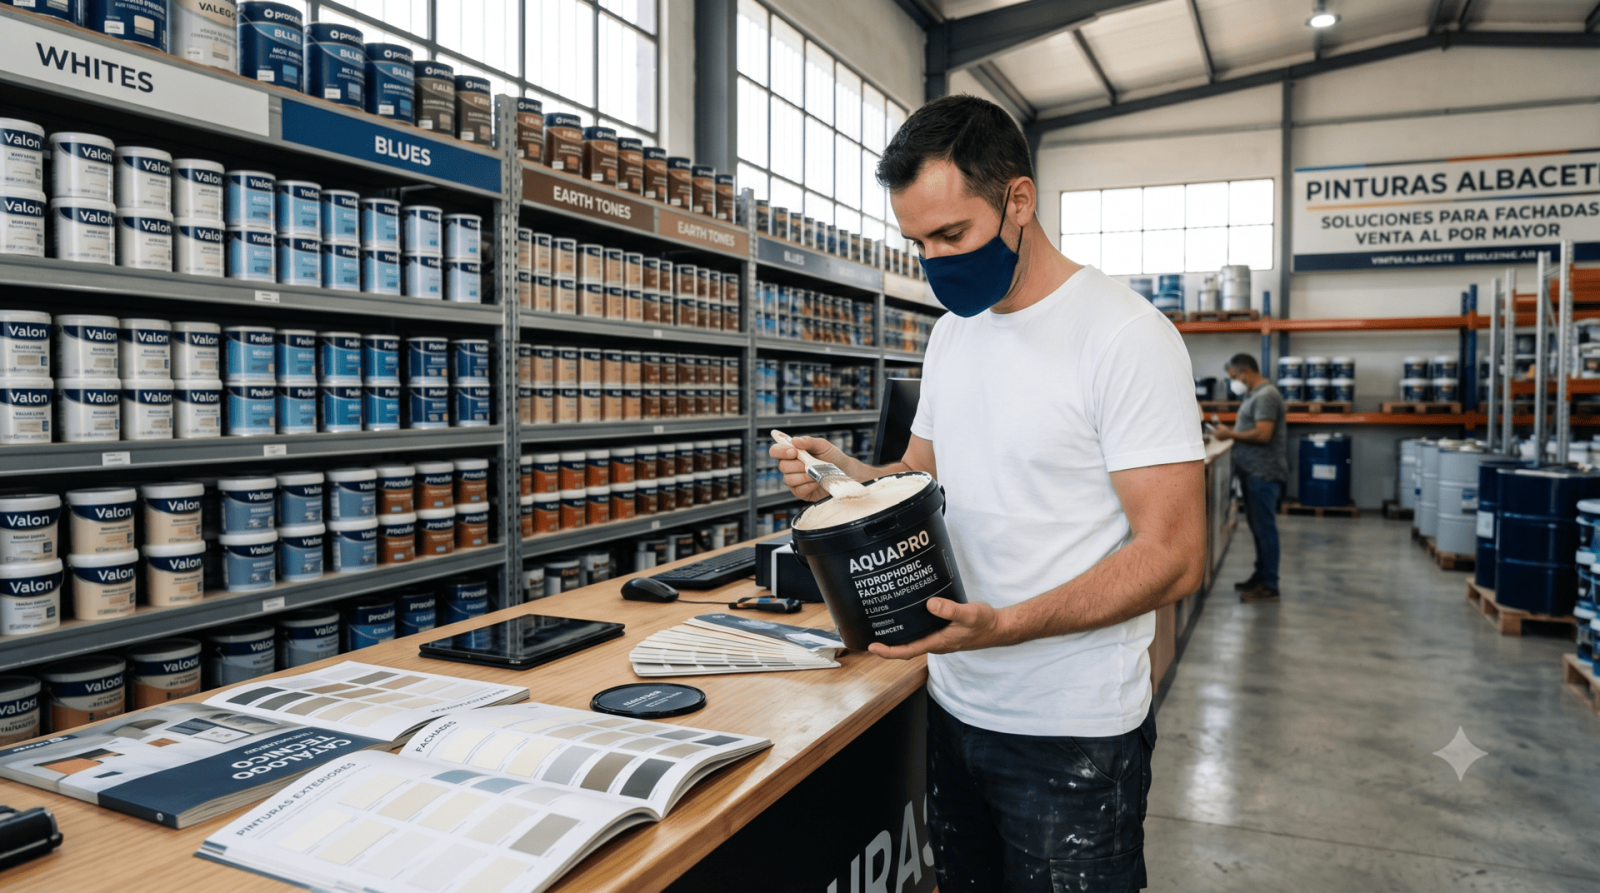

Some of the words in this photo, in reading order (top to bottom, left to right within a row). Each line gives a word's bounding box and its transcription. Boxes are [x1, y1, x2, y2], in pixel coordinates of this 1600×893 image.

[36, 42, 154, 93] WHITES
[4, 132, 41, 149] Valon
[82, 147, 112, 162] Valon
[375, 135, 431, 166] BLUES
[143, 160, 171, 174] Valon
[1307, 173, 1447, 200] PINTURAS
[1457, 163, 1600, 193] ALBACET
[4, 200, 42, 215] Valon
[553, 185, 593, 210] EARTH
[595, 197, 631, 220] TONES
[80, 211, 113, 225] Valon
[1321, 211, 1433, 229] SOLUCIONES
[1440, 208, 1489, 224] PARA
[1495, 202, 1600, 221] FACHADAS
[142, 220, 171, 233] Valon
[677, 221, 707, 240] EARTH
[708, 229, 736, 247] TONES
[1355, 229, 1414, 245] VENTA
[1419, 228, 1442, 244] AL
[1449, 227, 1486, 242] POR
[1492, 223, 1560, 240] MAYOR
[8, 326, 47, 338] Valon
[86, 329, 117, 342] Valon
[138, 332, 168, 344] Valon
[9, 392, 48, 403] Valon
[87, 392, 118, 403] Valon
[143, 392, 172, 403] Valon
[191, 392, 219, 403] Valon
[95, 507, 132, 519] Valon
[168, 500, 200, 512] Valon
[7, 514, 50, 527] Valon
[850, 530, 930, 574] AQUAPRO
[169, 558, 202, 570] Valon
[98, 569, 134, 581] Valon
[854, 560, 922, 589] HYDROPHOBIC
[858, 582, 896, 598] FACADE
[897, 564, 934, 587] COASING
[10, 580, 53, 594] Valon
[862, 593, 893, 606] PINTURA
[232, 739, 352, 779] CATÁLOGO
[236, 799, 294, 836] PINTURAS
[293, 762, 356, 799] EXTERIORES
